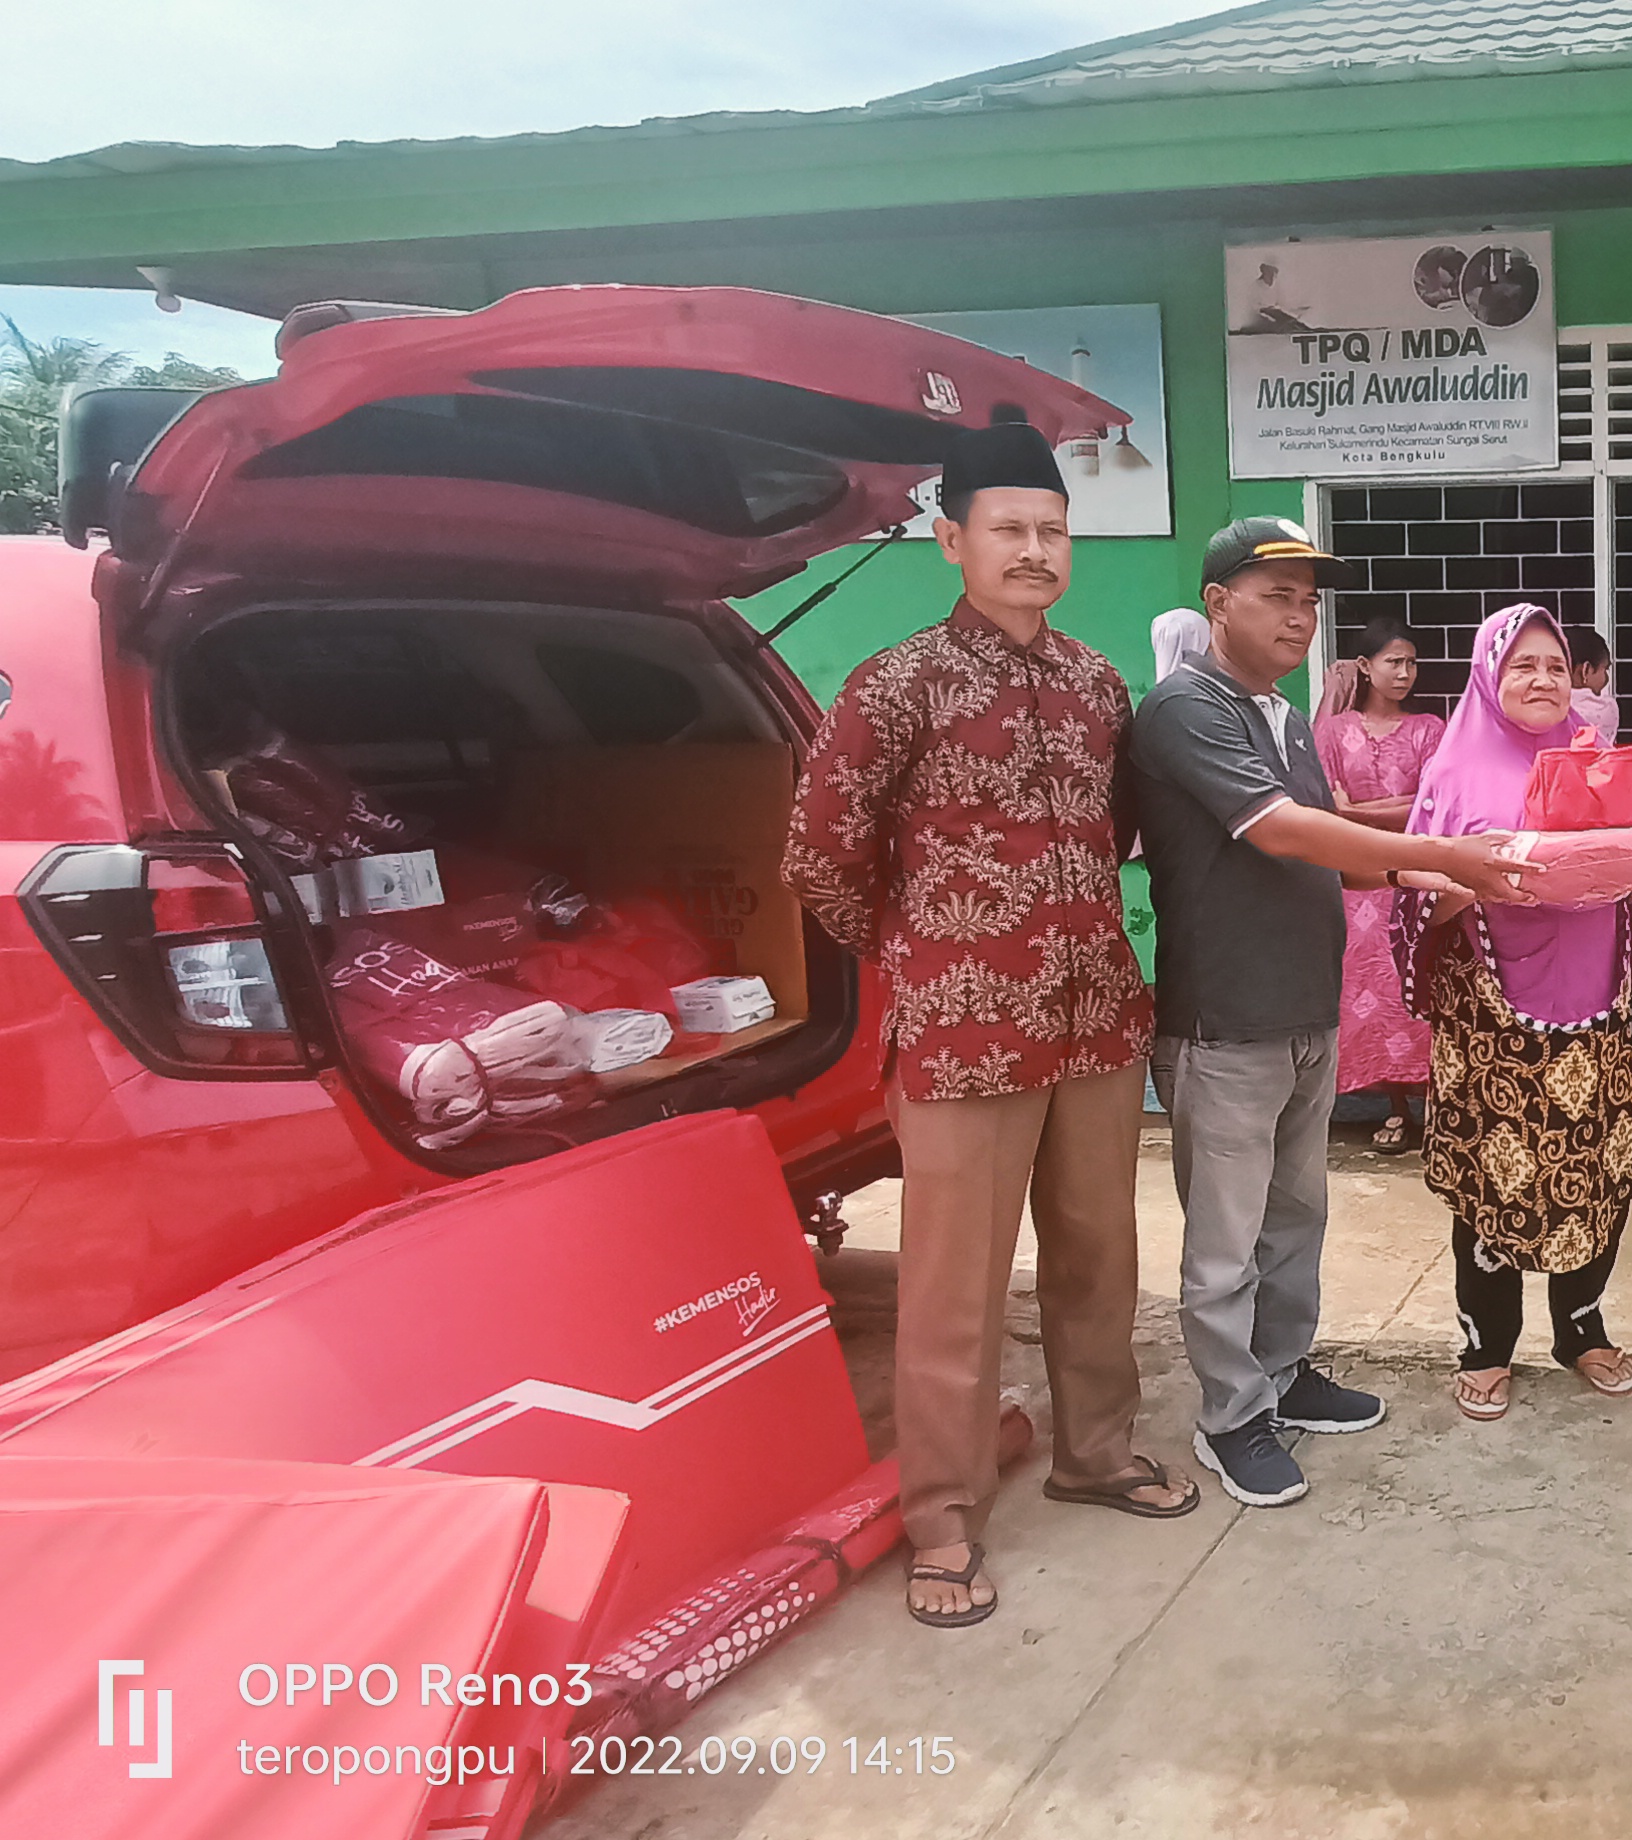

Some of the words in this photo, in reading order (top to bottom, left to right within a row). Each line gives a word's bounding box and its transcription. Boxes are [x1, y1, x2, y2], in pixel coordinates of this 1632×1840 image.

[1293, 332, 1370, 364] TPQ
[1381, 330, 1391, 361] /
[1402, 326, 1487, 360] MDA
[1257, 370, 1355, 417] Masjid
[1362, 364, 1528, 405] Awaluddin
[1258, 428, 1284, 438] Jalan
[1285, 426, 1316, 437] Basuki
[1359, 424, 1385, 436] Gang
[1387, 421, 1416, 434] Masjid
[1418, 419, 1467, 432] Awaluddin
[1280, 440, 1326, 452] Kelurahan
[1391, 436, 1443, 448] Kecamatan
[1446, 434, 1479, 447] Sungai
[1342, 452, 1374, 463] Kota
[1380, 449, 1445, 463] Bengkulu
[653, 1271, 761, 1333] #KEMENSOS
[734, 1285, 777, 1328] Hadir
